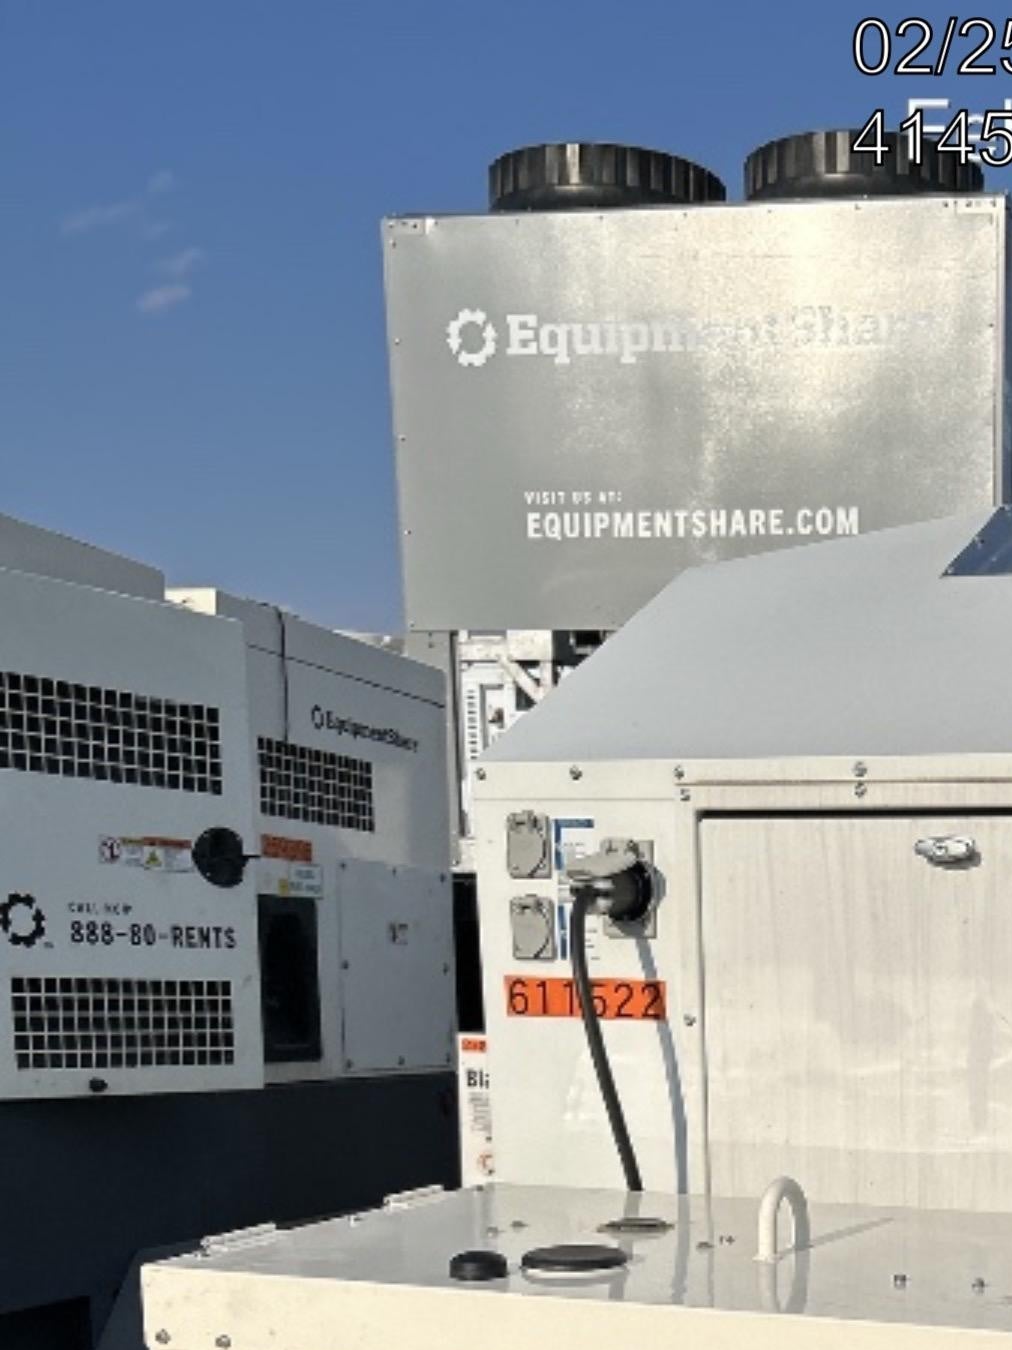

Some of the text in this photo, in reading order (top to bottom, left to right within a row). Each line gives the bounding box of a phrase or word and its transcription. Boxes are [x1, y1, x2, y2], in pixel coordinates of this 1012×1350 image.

[505, 304, 935, 365] EquipmntSha
[523, 490, 565, 505] VISIT
[526, 506, 860, 540] EQUIPMENTSHARE.COM
[70, 919, 238, 949] 888-80-RENTS
[509, 978, 663, 1019] 611522
